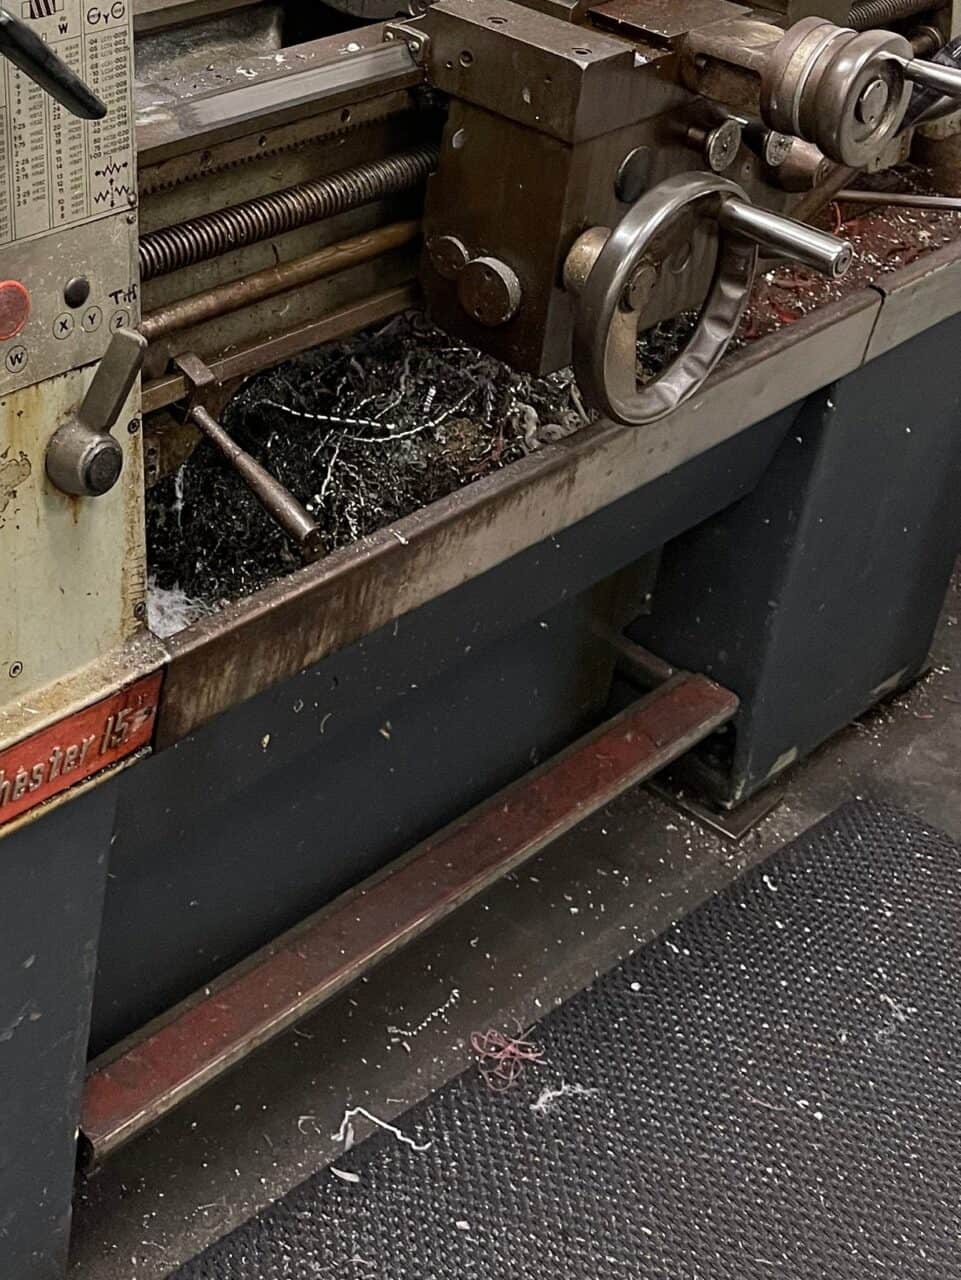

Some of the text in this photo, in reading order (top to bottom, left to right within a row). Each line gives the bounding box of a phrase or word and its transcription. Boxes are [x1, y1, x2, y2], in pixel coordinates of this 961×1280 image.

[58, 22, 69, 35] W
[87, 313, 97, 326] Y
[115, 316, 123, 329] Z
[58, 320, 70, 333] X
[9, 352, 25, 366] W
